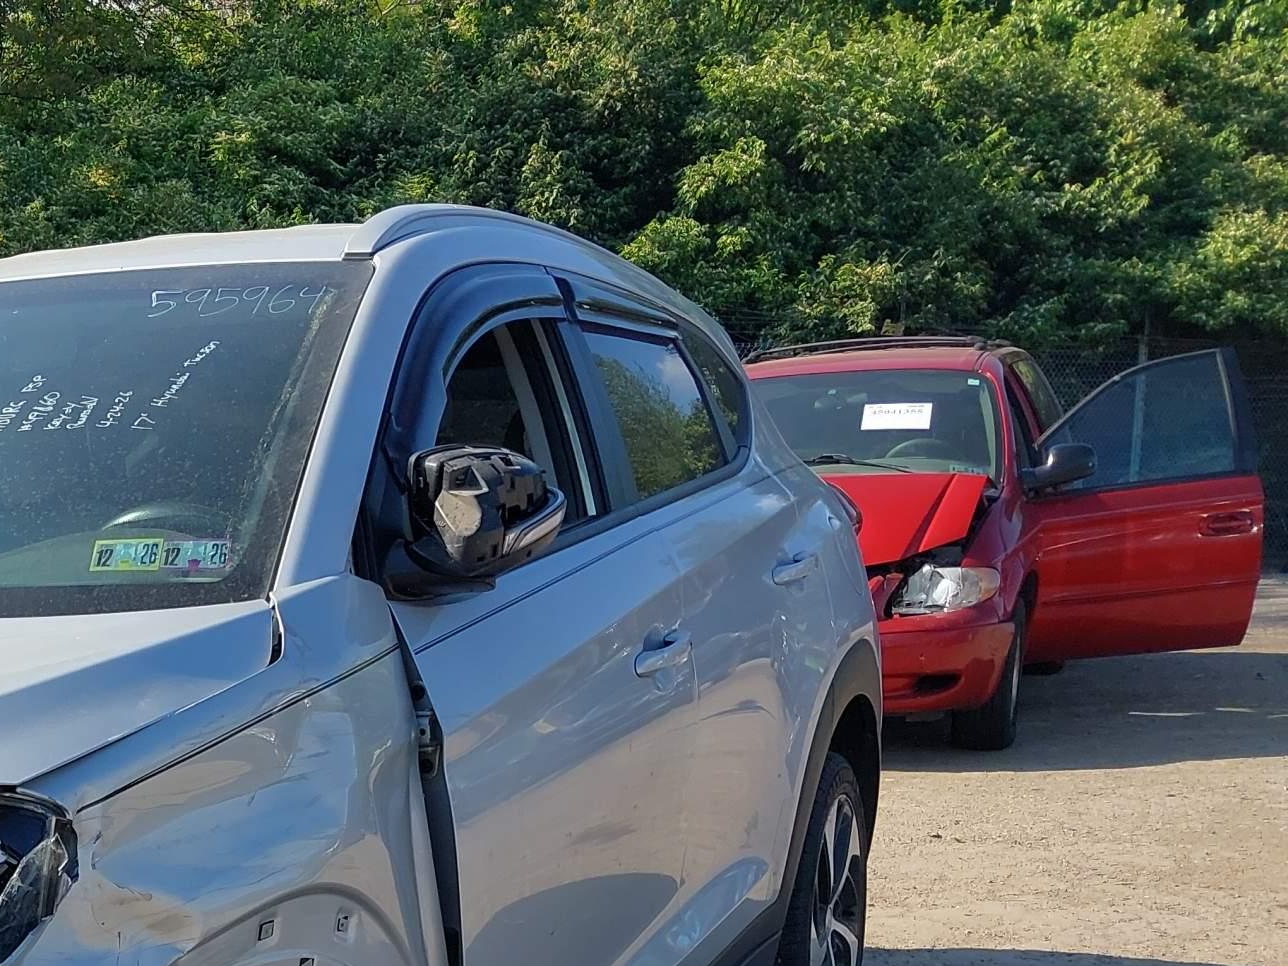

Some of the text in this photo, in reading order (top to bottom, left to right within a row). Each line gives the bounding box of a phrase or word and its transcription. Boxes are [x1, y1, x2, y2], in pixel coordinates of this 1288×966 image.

[147, 285, 328, 317] 595964
[96, 543, 159, 567] 12 26
[163, 543, 228, 566] 12 26
